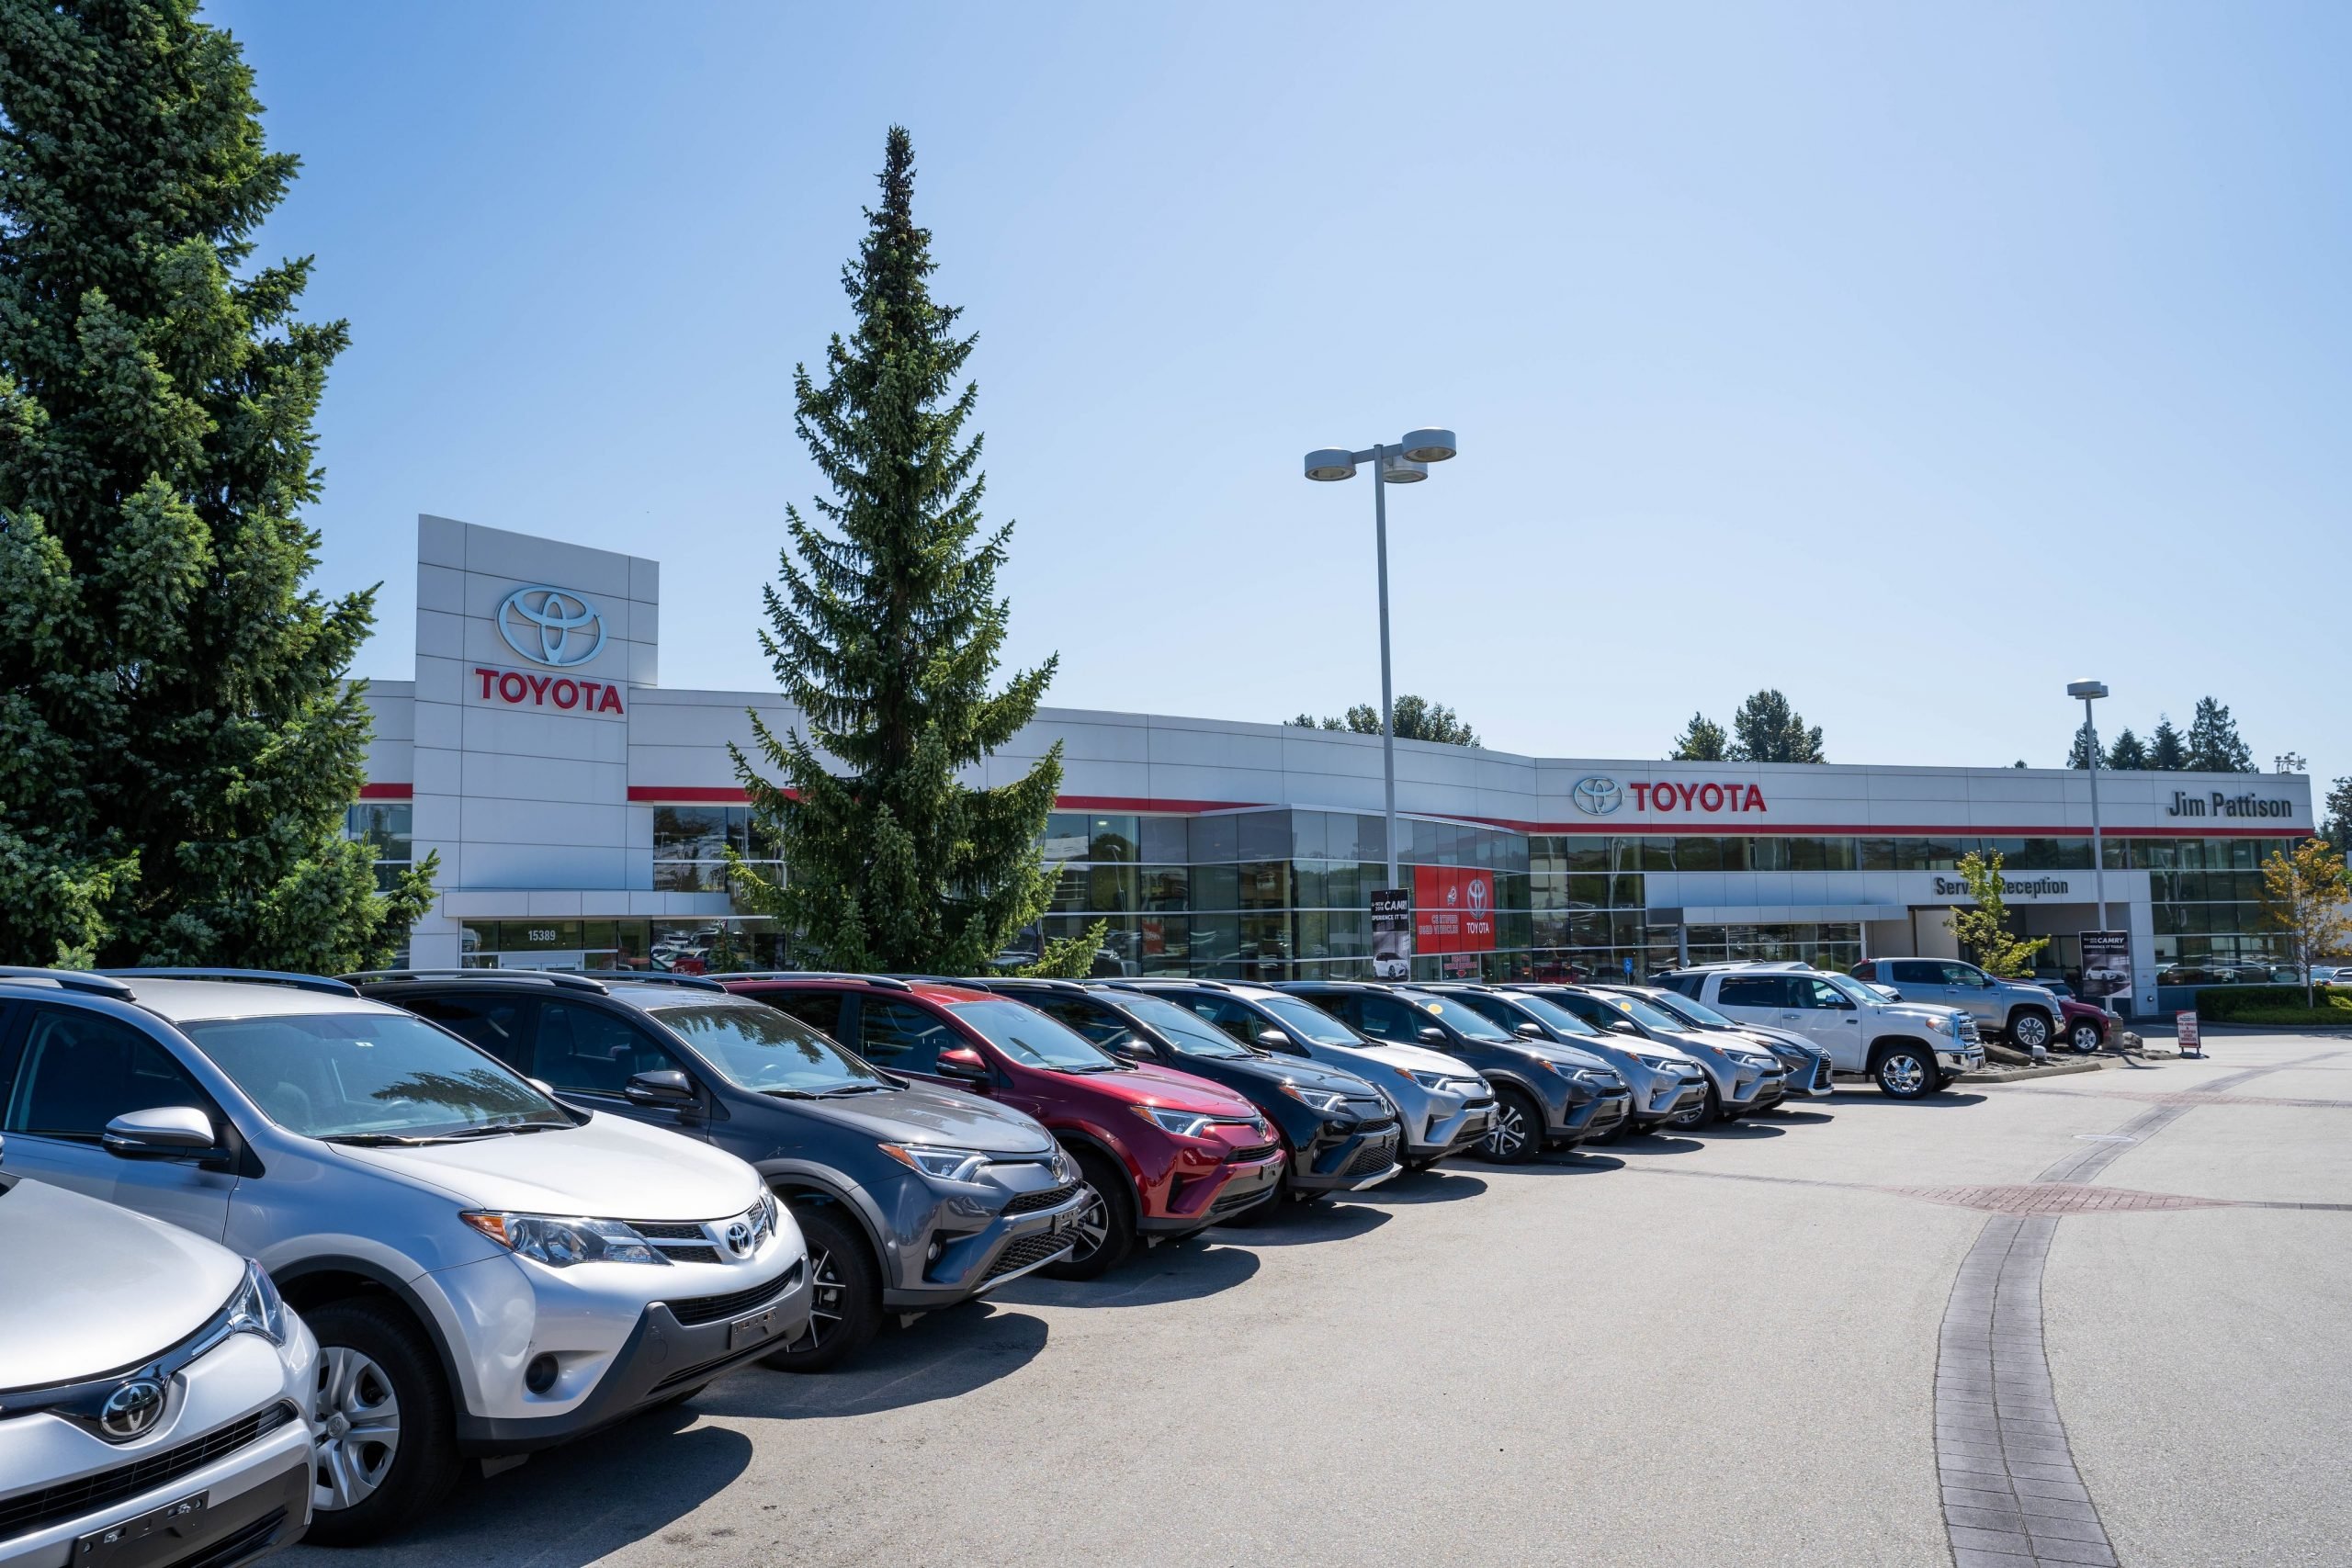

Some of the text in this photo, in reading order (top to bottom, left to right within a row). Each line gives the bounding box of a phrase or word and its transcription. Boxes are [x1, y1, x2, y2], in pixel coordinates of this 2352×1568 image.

[474, 668, 624, 715] TOYOTA
[1630, 782, 1768, 812] TOYOTA
[2167, 791, 2292, 818] Jim Pattison
[527, 930, 556, 942] 15389
[1466, 921, 1490, 934] TOYOTA
